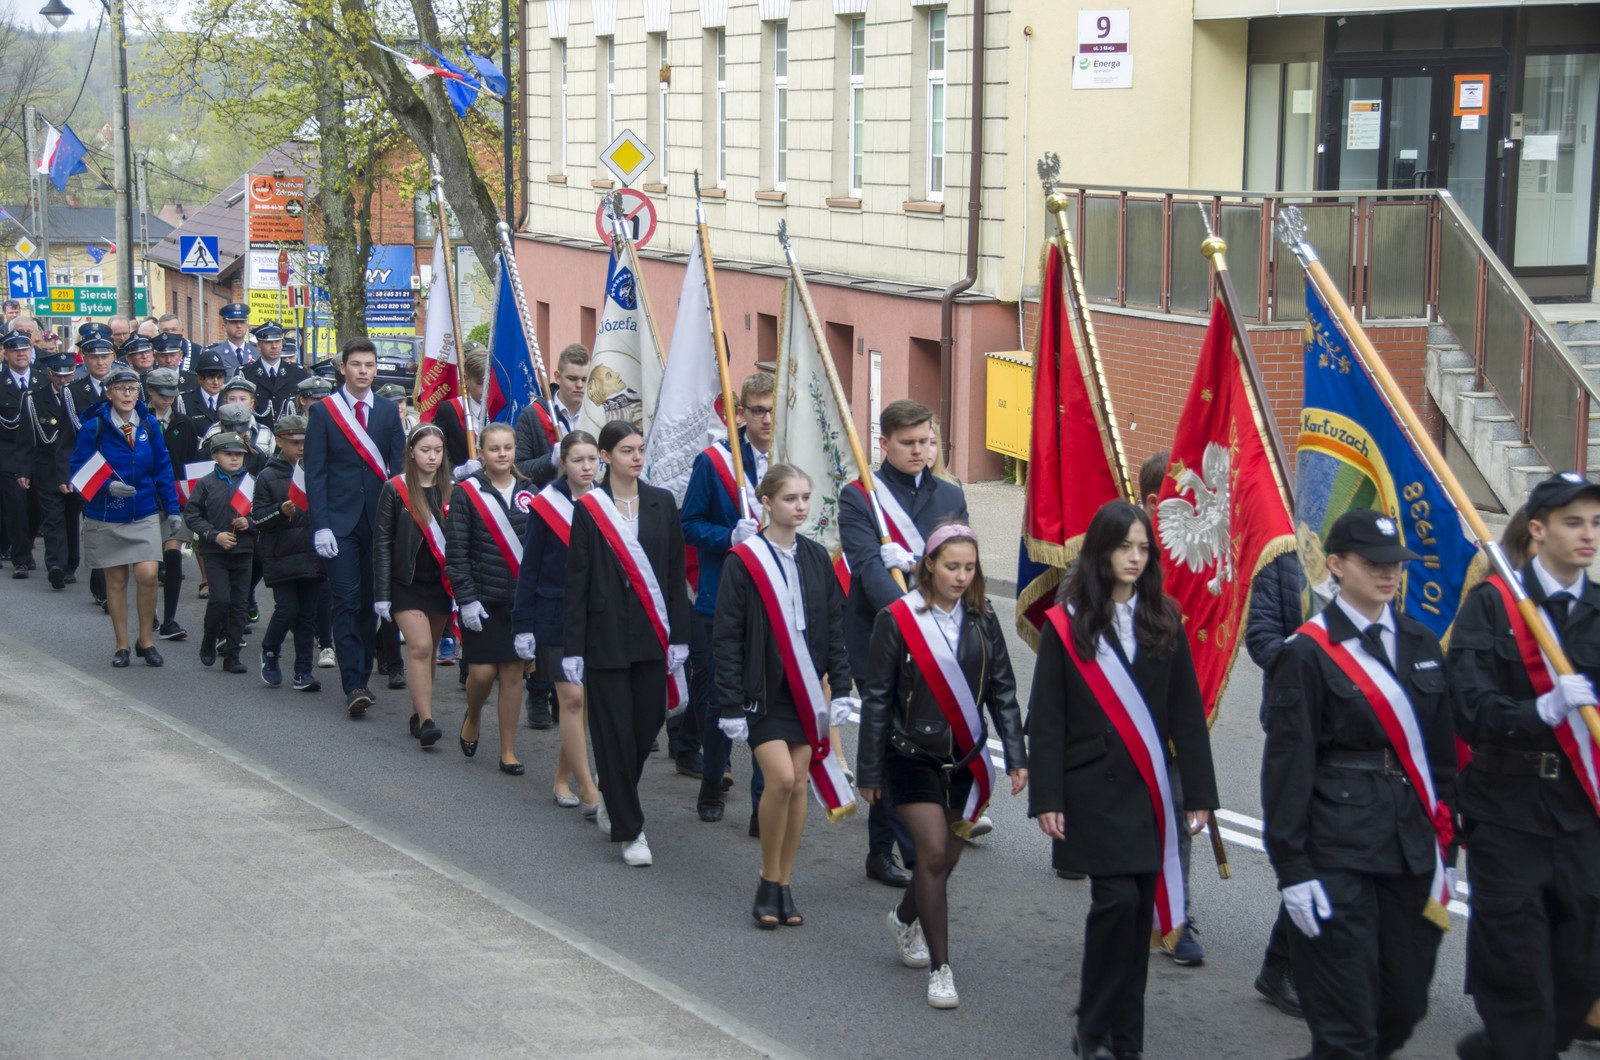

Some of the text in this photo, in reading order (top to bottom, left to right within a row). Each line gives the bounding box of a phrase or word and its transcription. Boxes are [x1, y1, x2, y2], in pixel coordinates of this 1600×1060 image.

[1096, 16, 1111, 38] 9
[1094, 60, 1120, 68] Energa
[58, 289, 69, 297] 211
[295, 288, 304, 305] H
[80, 303, 112, 314] Bytów
[598, 316, 638, 334] Józefa
[423, 333, 455, 386] Pileckiego
[1304, 414, 1369, 458] Kartuzach
[1403, 481, 1436, 546] 1938
